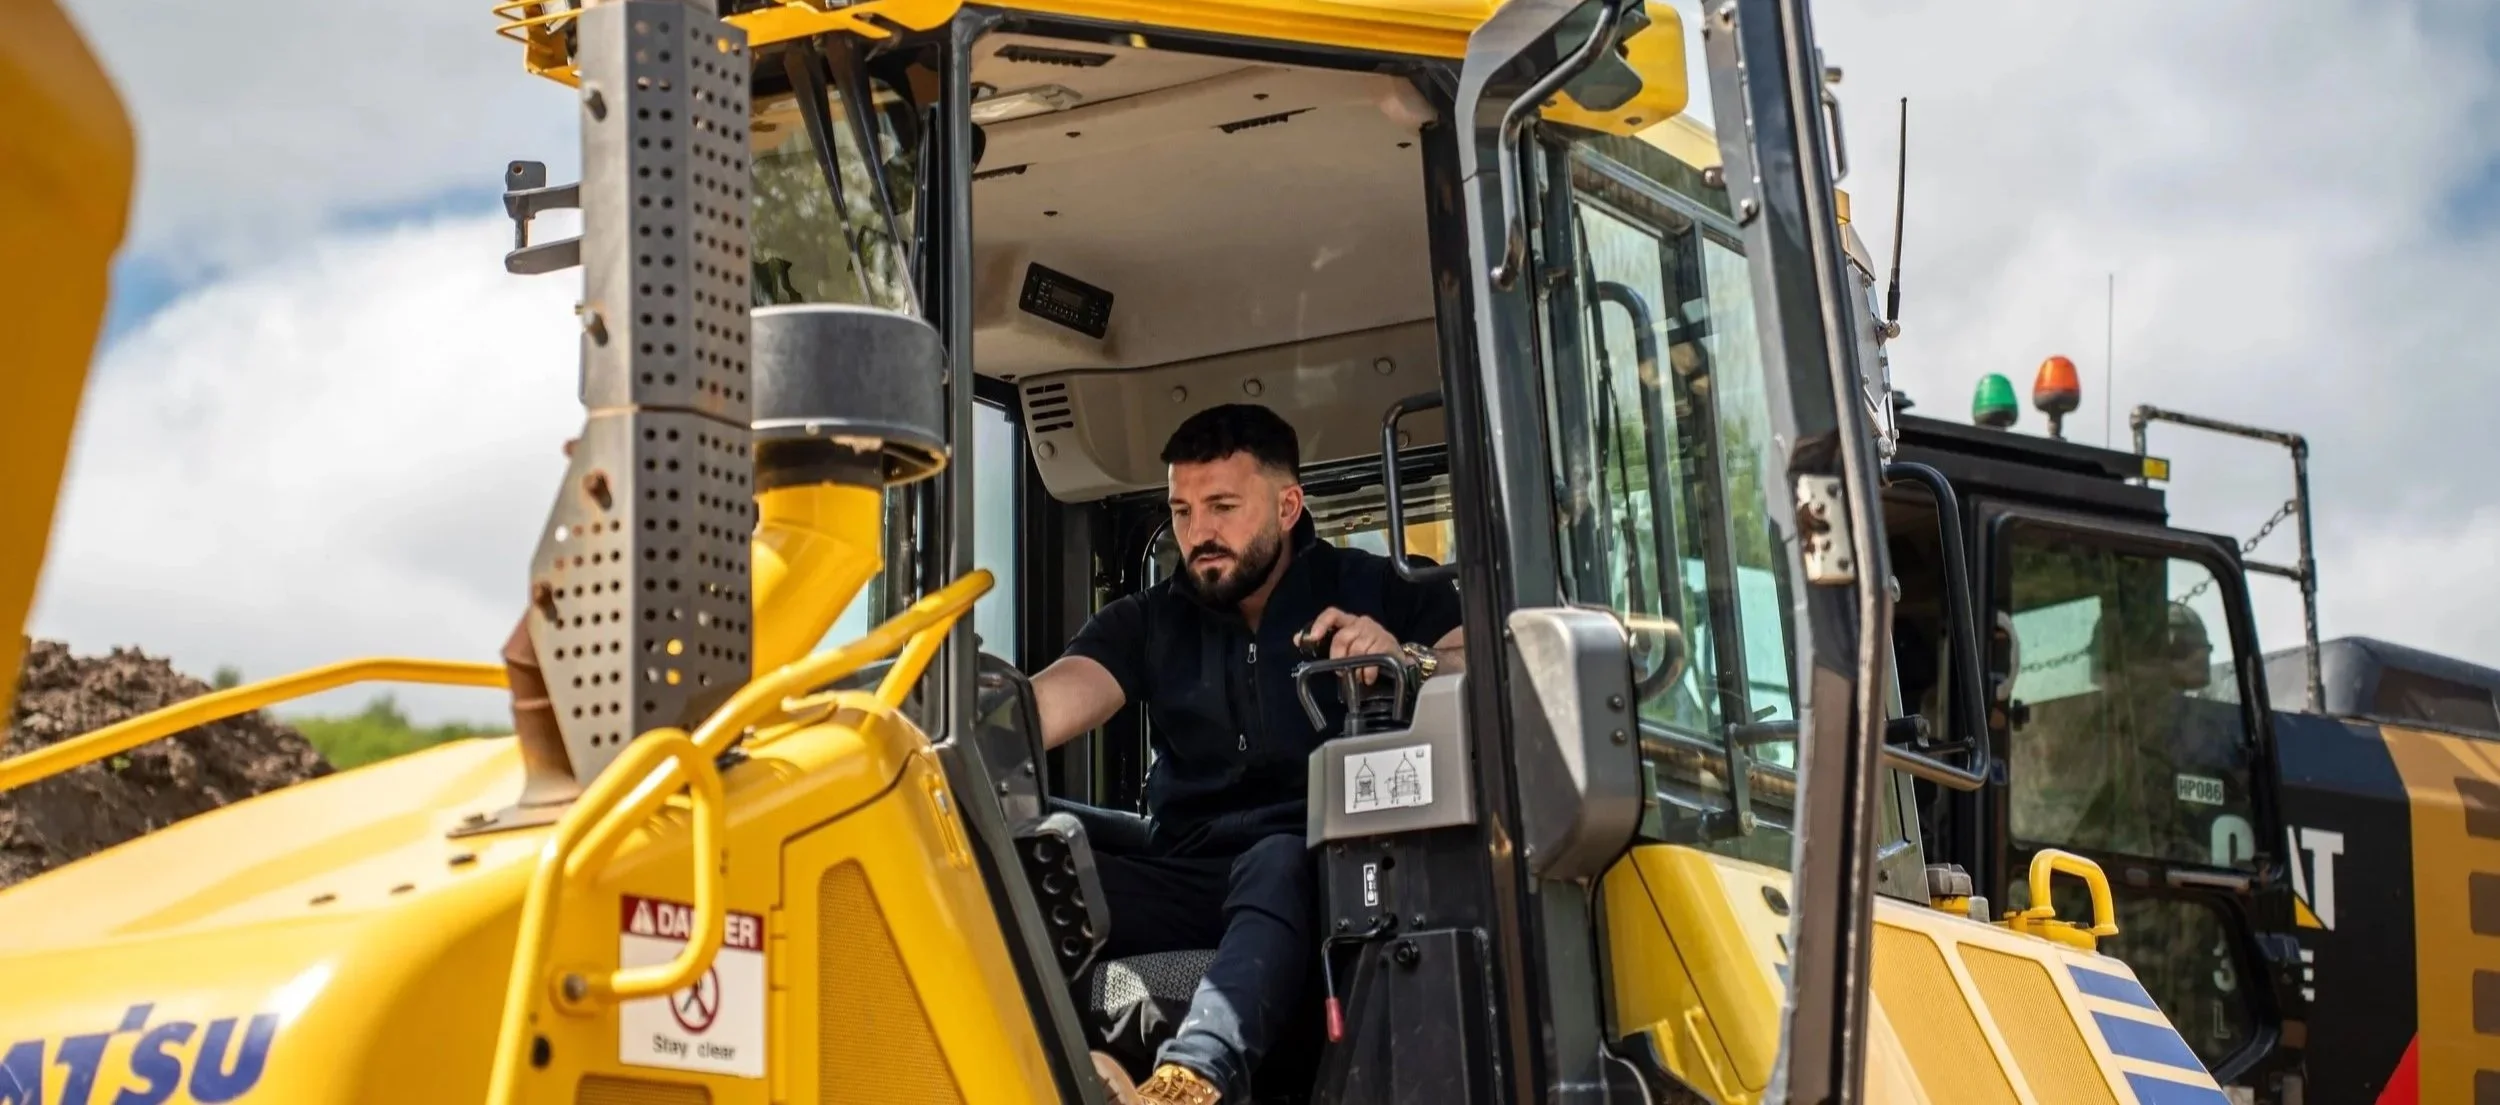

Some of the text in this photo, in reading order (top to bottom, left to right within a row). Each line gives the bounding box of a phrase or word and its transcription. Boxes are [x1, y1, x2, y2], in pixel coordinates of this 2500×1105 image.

[2180, 779, 2222, 801] HP086
[656, 903, 758, 948] DAER
[652, 1033, 736, 1060] Stay clear
